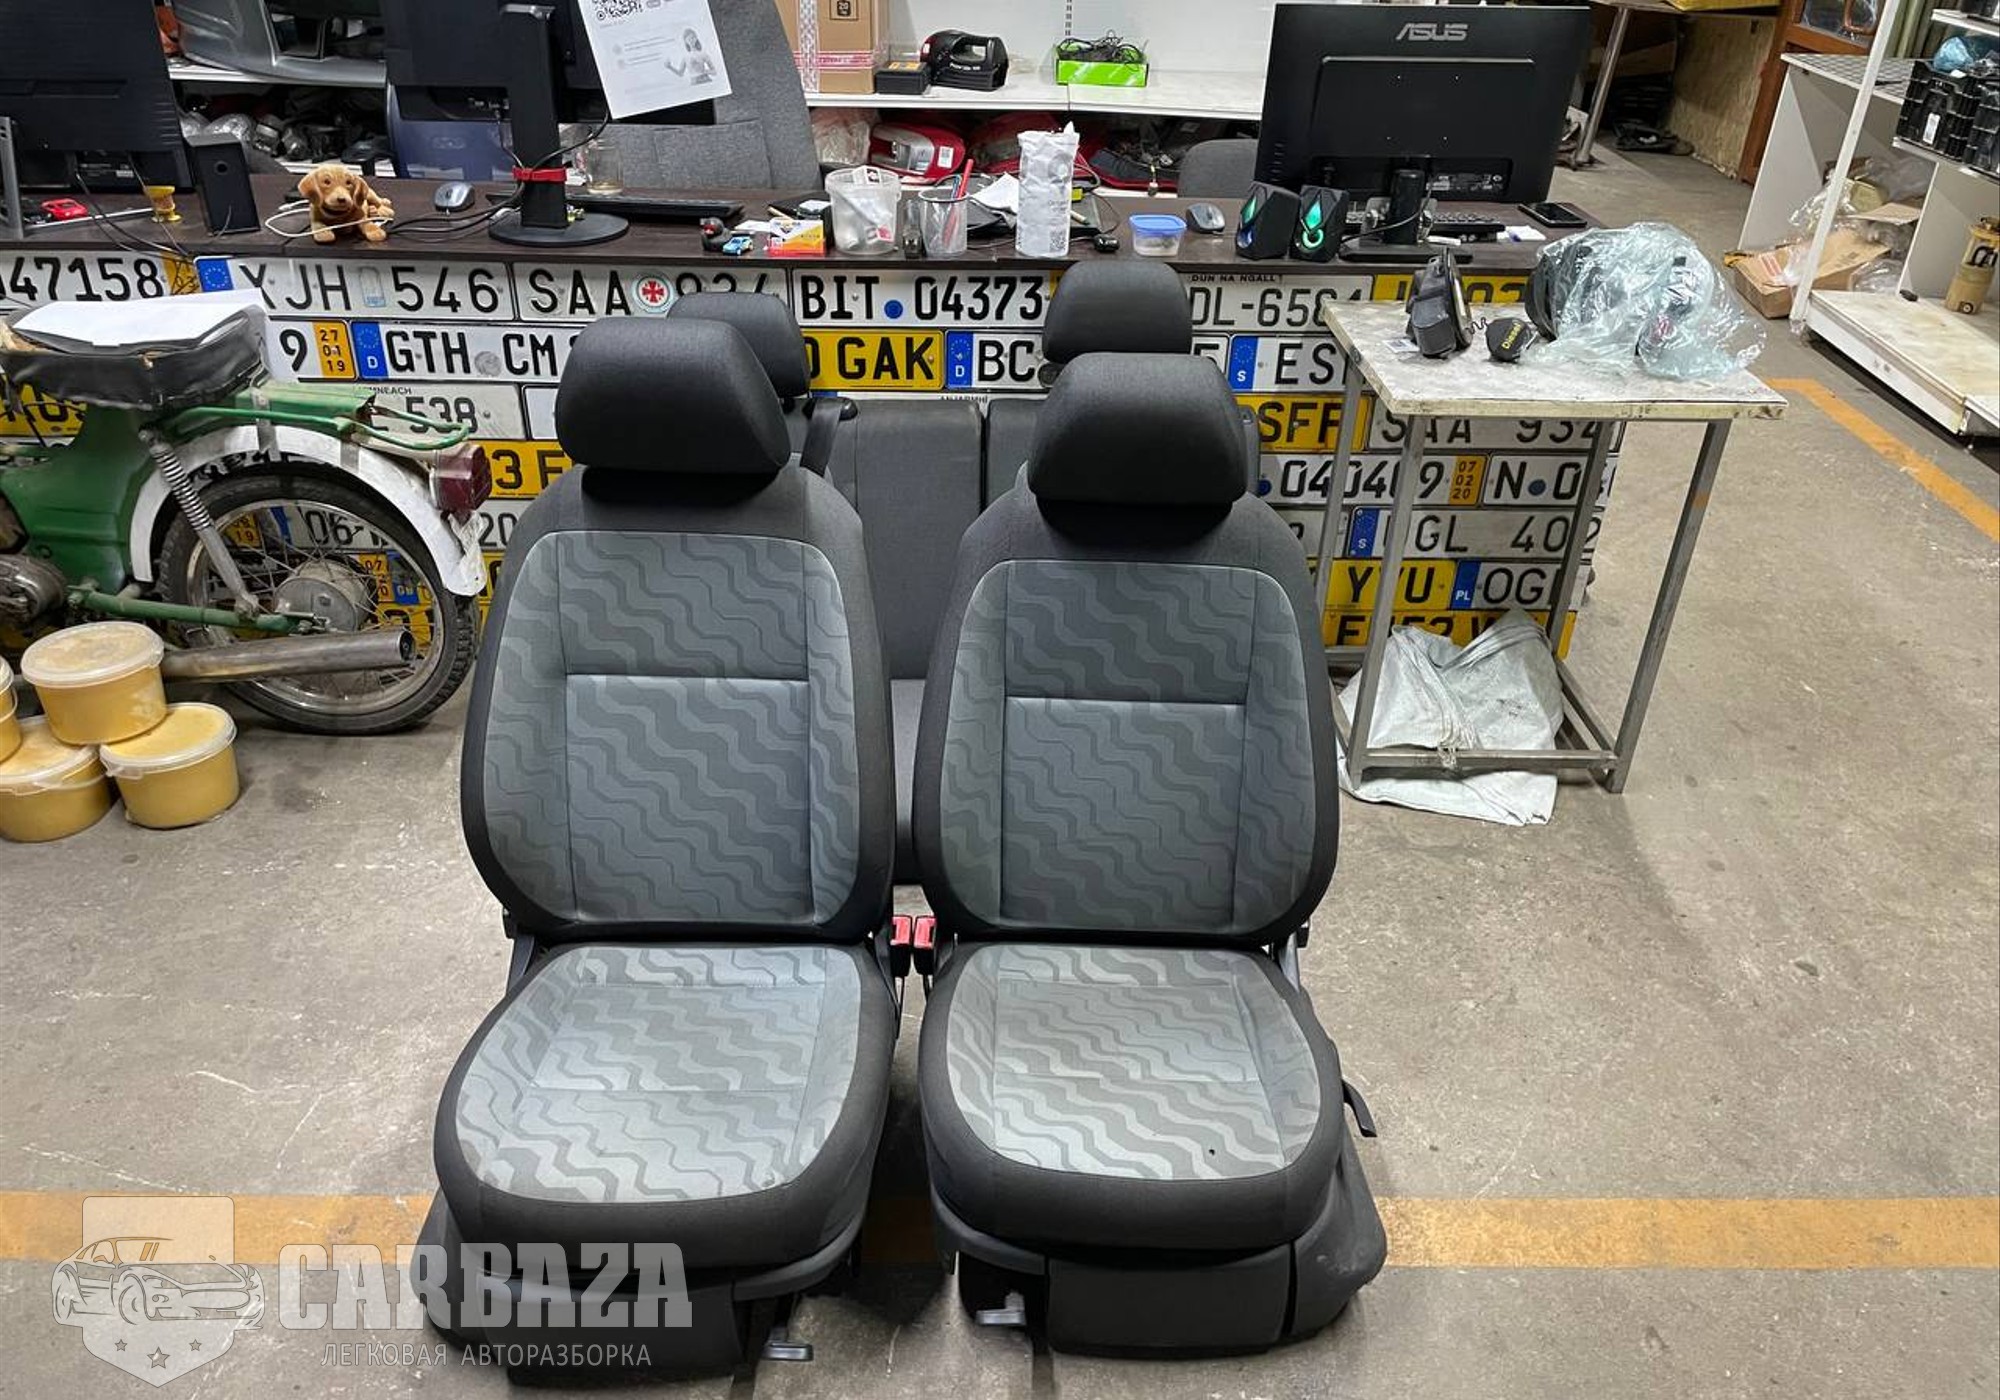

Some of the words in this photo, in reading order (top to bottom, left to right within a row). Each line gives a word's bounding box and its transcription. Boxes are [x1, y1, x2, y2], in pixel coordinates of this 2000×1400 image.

[1396, 23, 1468, 41] ASUS
[0, 257, 163, 301] 47158
[391, 266, 499, 313] 546
[529, 269, 631, 316] SAA
[800, 275, 879, 320] BIT
[914, 276, 1042, 321] 04373
[319, 329, 339, 342] 27
[326, 360, 346, 372] 19
[366, 355, 377, 369] D
[385, 330, 471, 374] GTH
[502, 333, 558, 377] CM
[836, 336, 934, 380] GAK
[977, 339, 1036, 382] BC
[1275, 342, 1366, 385] ES
[955, 365, 965, 377] D
[1237, 370, 1247, 382] S
[405, 396, 478, 434] 538
[1455, 474, 1474, 486] 02
[1458, 461, 1477, 473] 07
[1452, 488, 1471, 500] 20
[1357, 538, 1368, 549] S
[1383, 515, 1469, 552] GL
[1348, 566, 1436, 604] YU
[1455, 590, 1471, 601] PL
